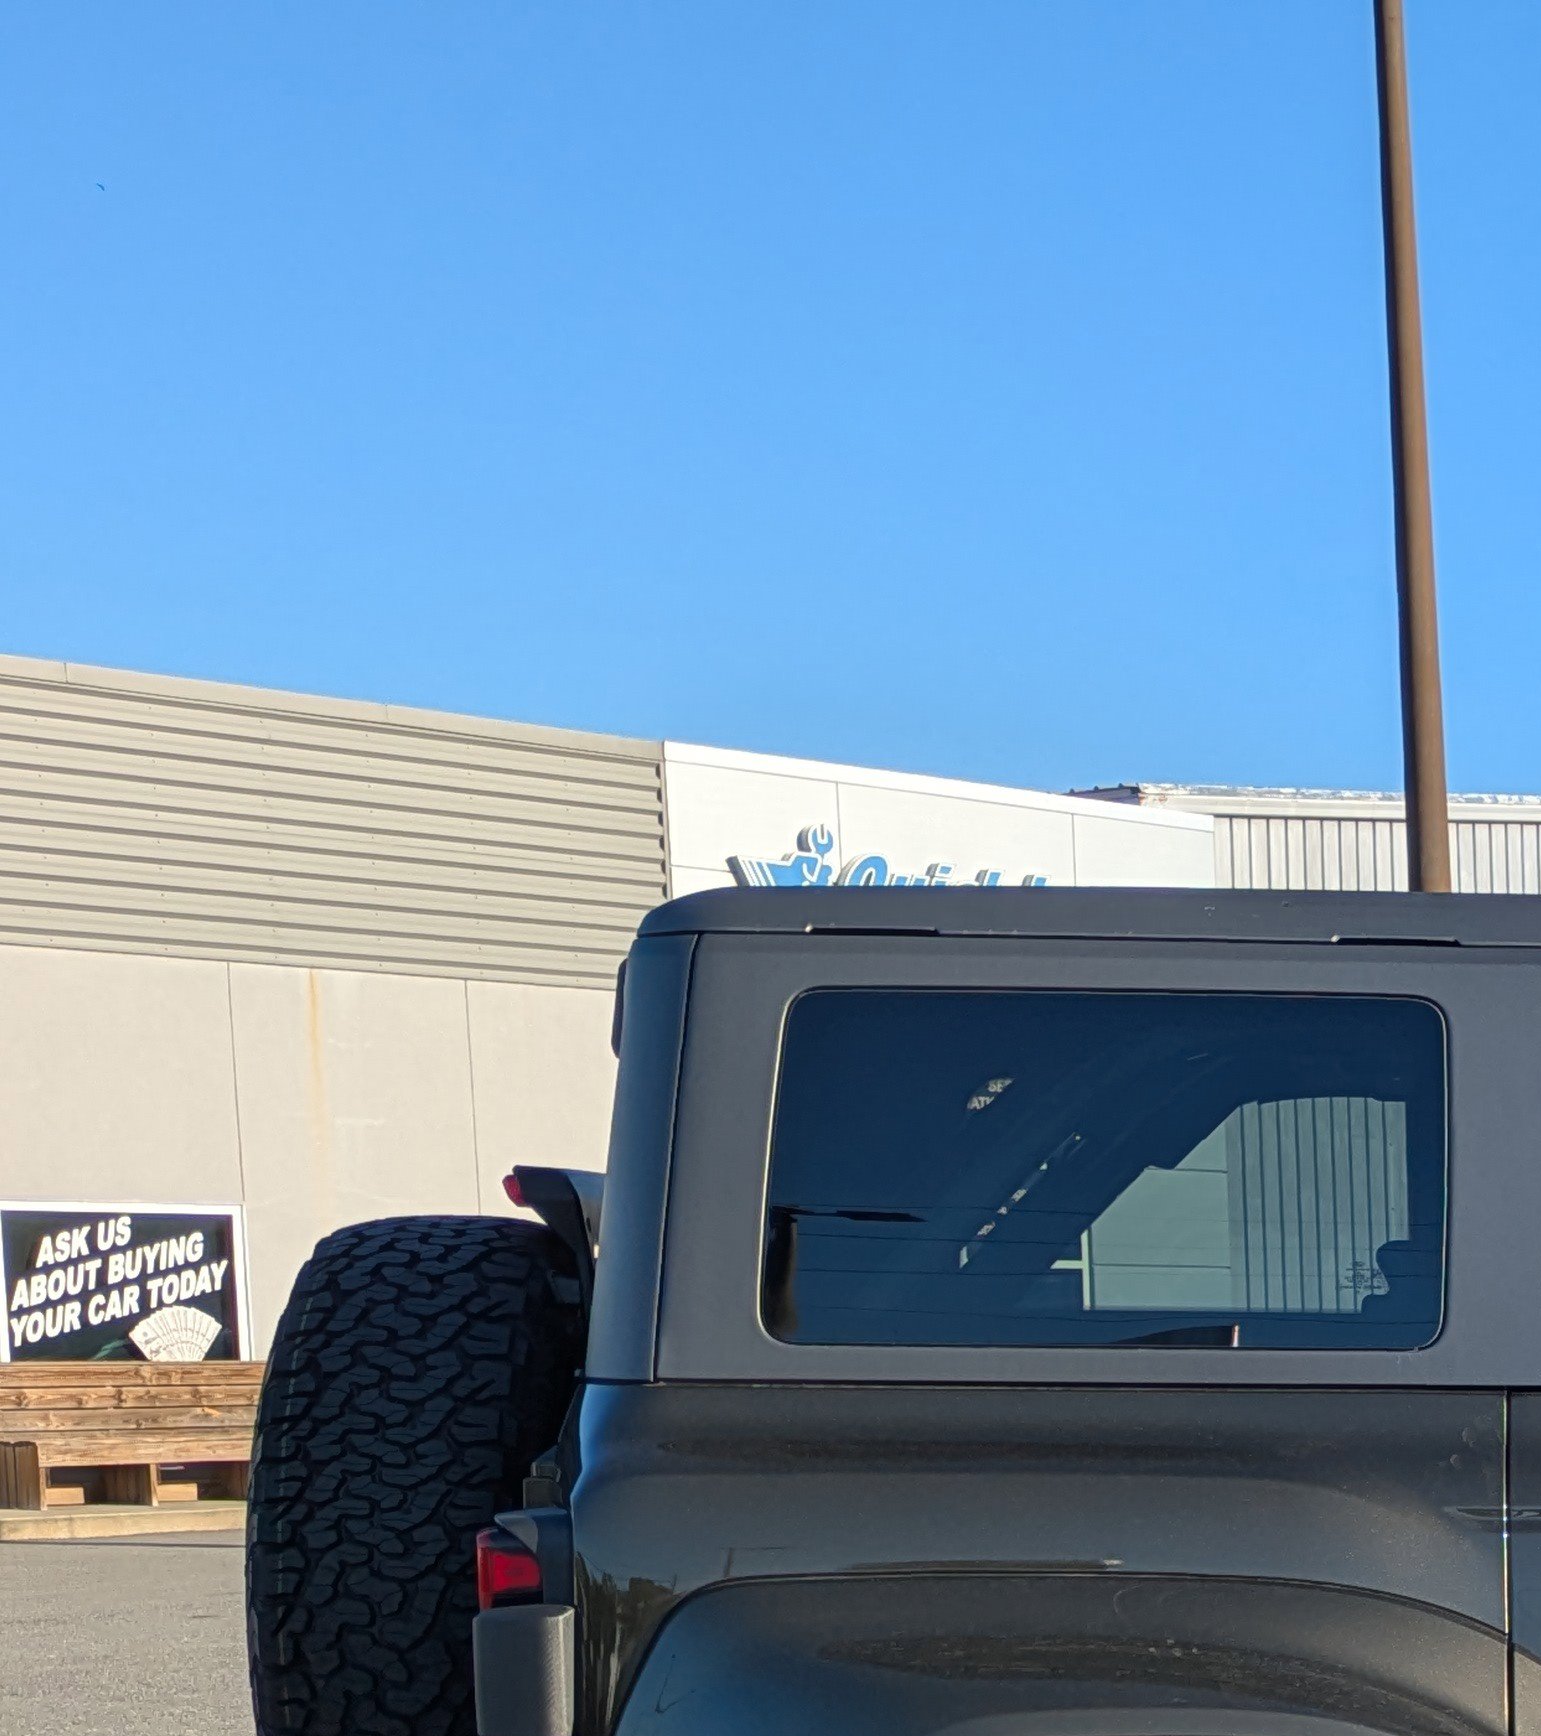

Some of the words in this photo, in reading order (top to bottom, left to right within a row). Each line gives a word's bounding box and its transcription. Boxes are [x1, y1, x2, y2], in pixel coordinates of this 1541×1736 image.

[11, 1258, 102, 1312] ABOUT
[107, 1232, 204, 1284] BUYING
[35, 1225, 91, 1268] ASK
[97, 1216, 131, 1250] US
[10, 1301, 82, 1347] YOUR
[87, 1285, 140, 1325] CAR
[146, 1260, 228, 1308] TODAY
